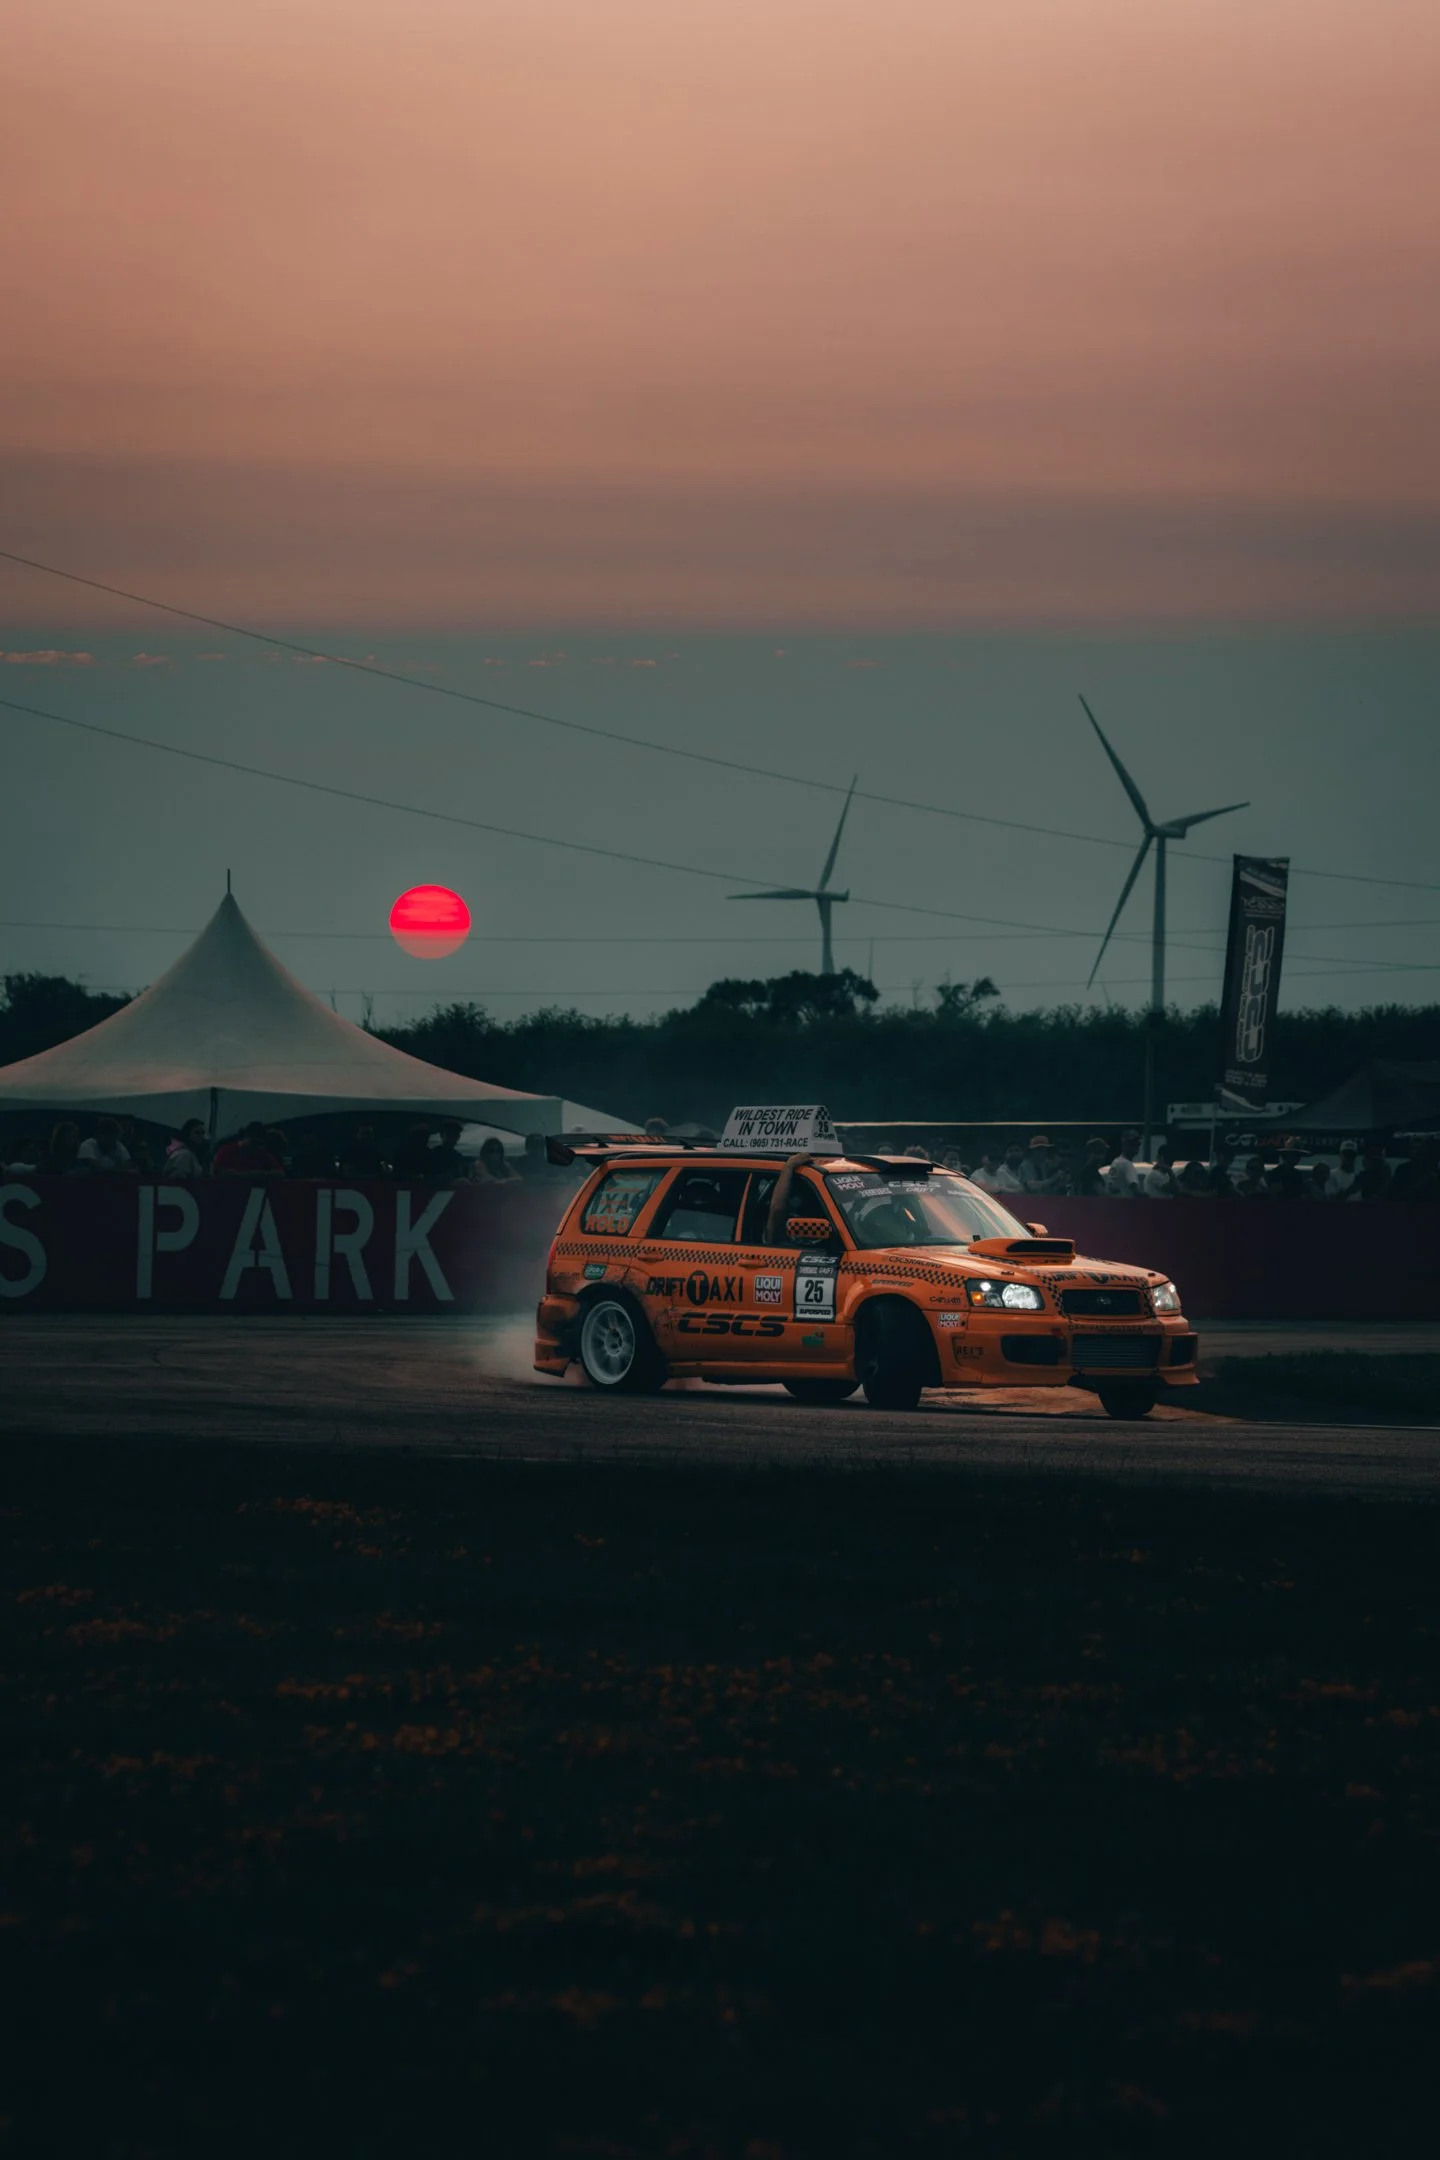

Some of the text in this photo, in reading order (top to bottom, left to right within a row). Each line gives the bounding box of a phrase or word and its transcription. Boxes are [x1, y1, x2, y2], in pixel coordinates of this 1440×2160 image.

[735, 1108, 813, 1120] WILDEST RIDE
[739, 1121, 798, 1135] IN TOWN
[723, 1138, 808, 1148] CALL: (905) 731-RACE
[838, 1182, 865, 1191] MOLY
[0, 1183, 456, 1300] S PARK
[645, 1276, 686, 1297] DRIFT
[756, 1278, 780, 1289] LIQUI
[755, 1290, 780, 1301] MOLY
[805, 1280, 824, 1303] 25
[679, 1312, 788, 1337] CSCS
